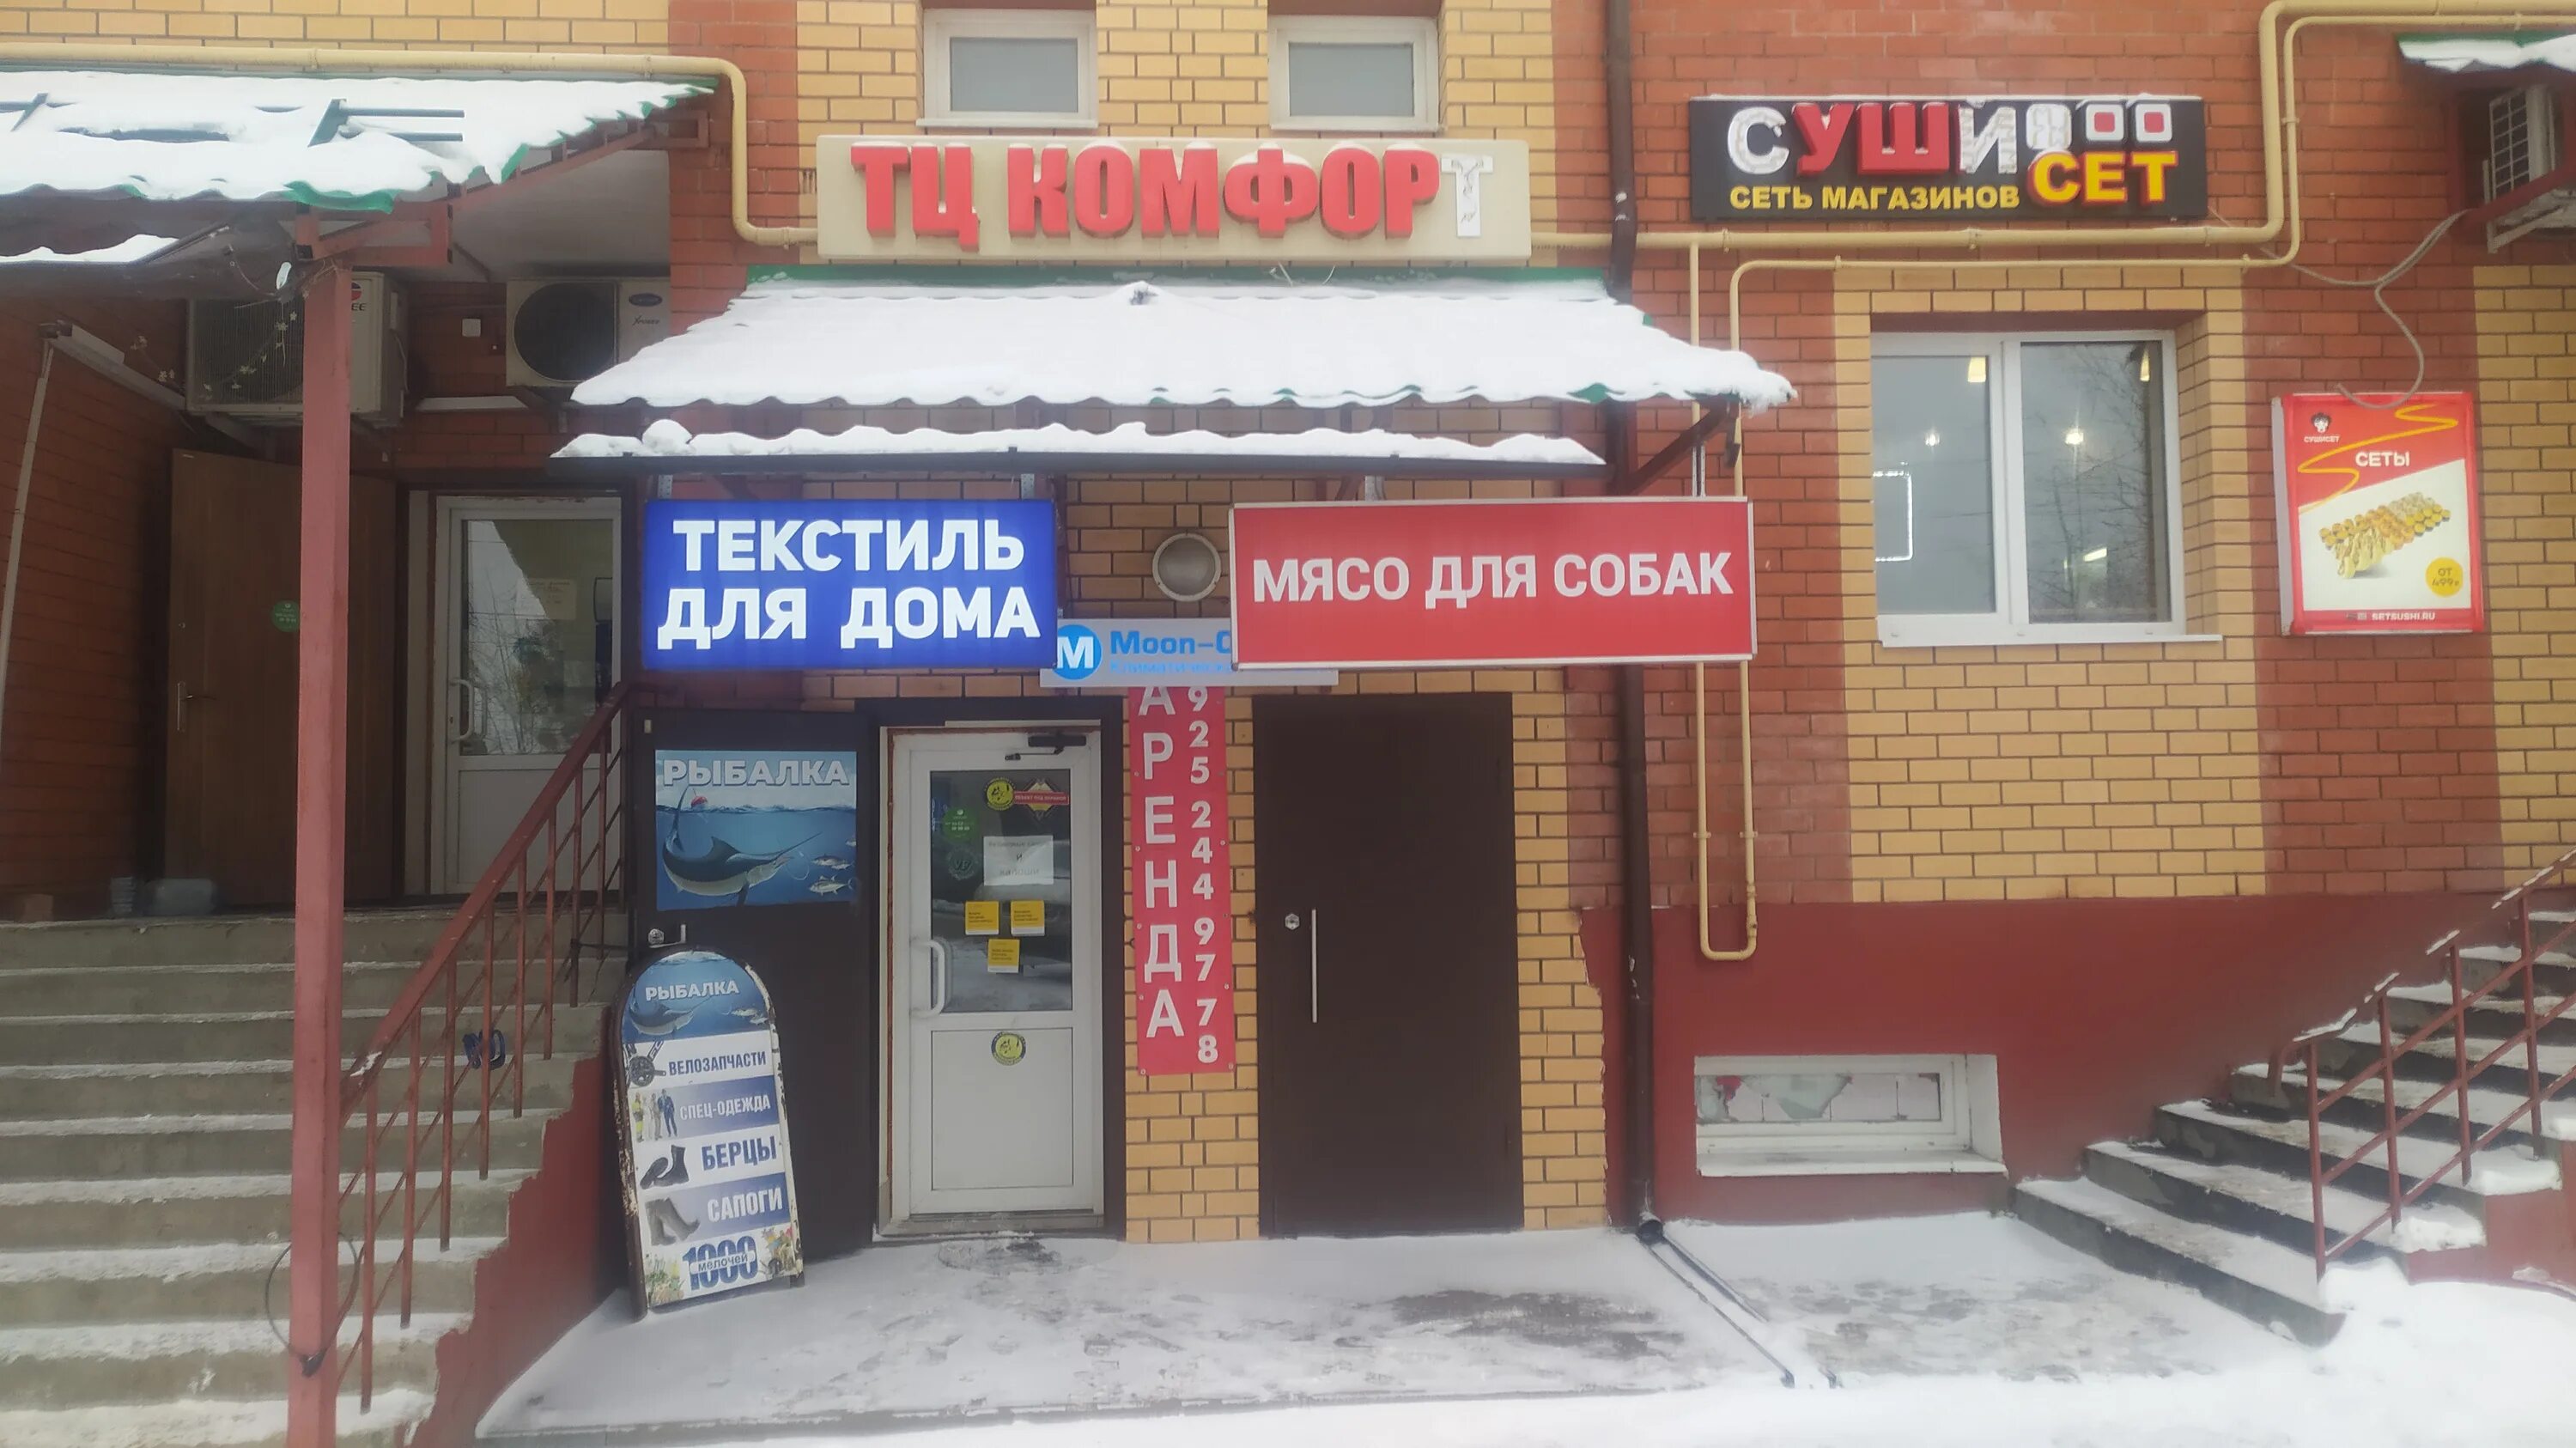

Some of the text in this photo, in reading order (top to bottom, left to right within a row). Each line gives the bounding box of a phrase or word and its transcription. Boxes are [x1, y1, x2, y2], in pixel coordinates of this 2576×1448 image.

[1727, 100, 2018, 176] СУШИ
[2028, 149, 2178, 207] СЕТ
[850, 141, 1494, 252] ТЦ КОМФОРТ
[1729, 185, 2021, 210] СЕТЬ МАГАЗИНОВ
[2354, 451, 2410, 467] СЕТЫ
[673, 520, 1024, 571] ТЕКСТИЛЬ
[1253, 551, 1734, 609] МЯСО ДЛЯ СОБАК
[657, 586, 1041, 650] ДЛЯ ДОМА
[662, 759, 850, 787] РЫБАЛКА
[1138, 686, 1184, 1038] АРЕНДА
[645, 981, 739, 1001] РЫБАЛКА
[668, 1050, 767, 1076] ВЕЛОЗАПЧАСТИ
[679, 1094, 771, 1121] СПЕЦ-ОДЕЖДА
[702, 1135, 777, 1171] БЕРЦЫ
[707, 1187, 783, 1222] САПОГИ
[682, 1235, 758, 1291] 1000
[698, 1252, 748, 1272] мелочей
